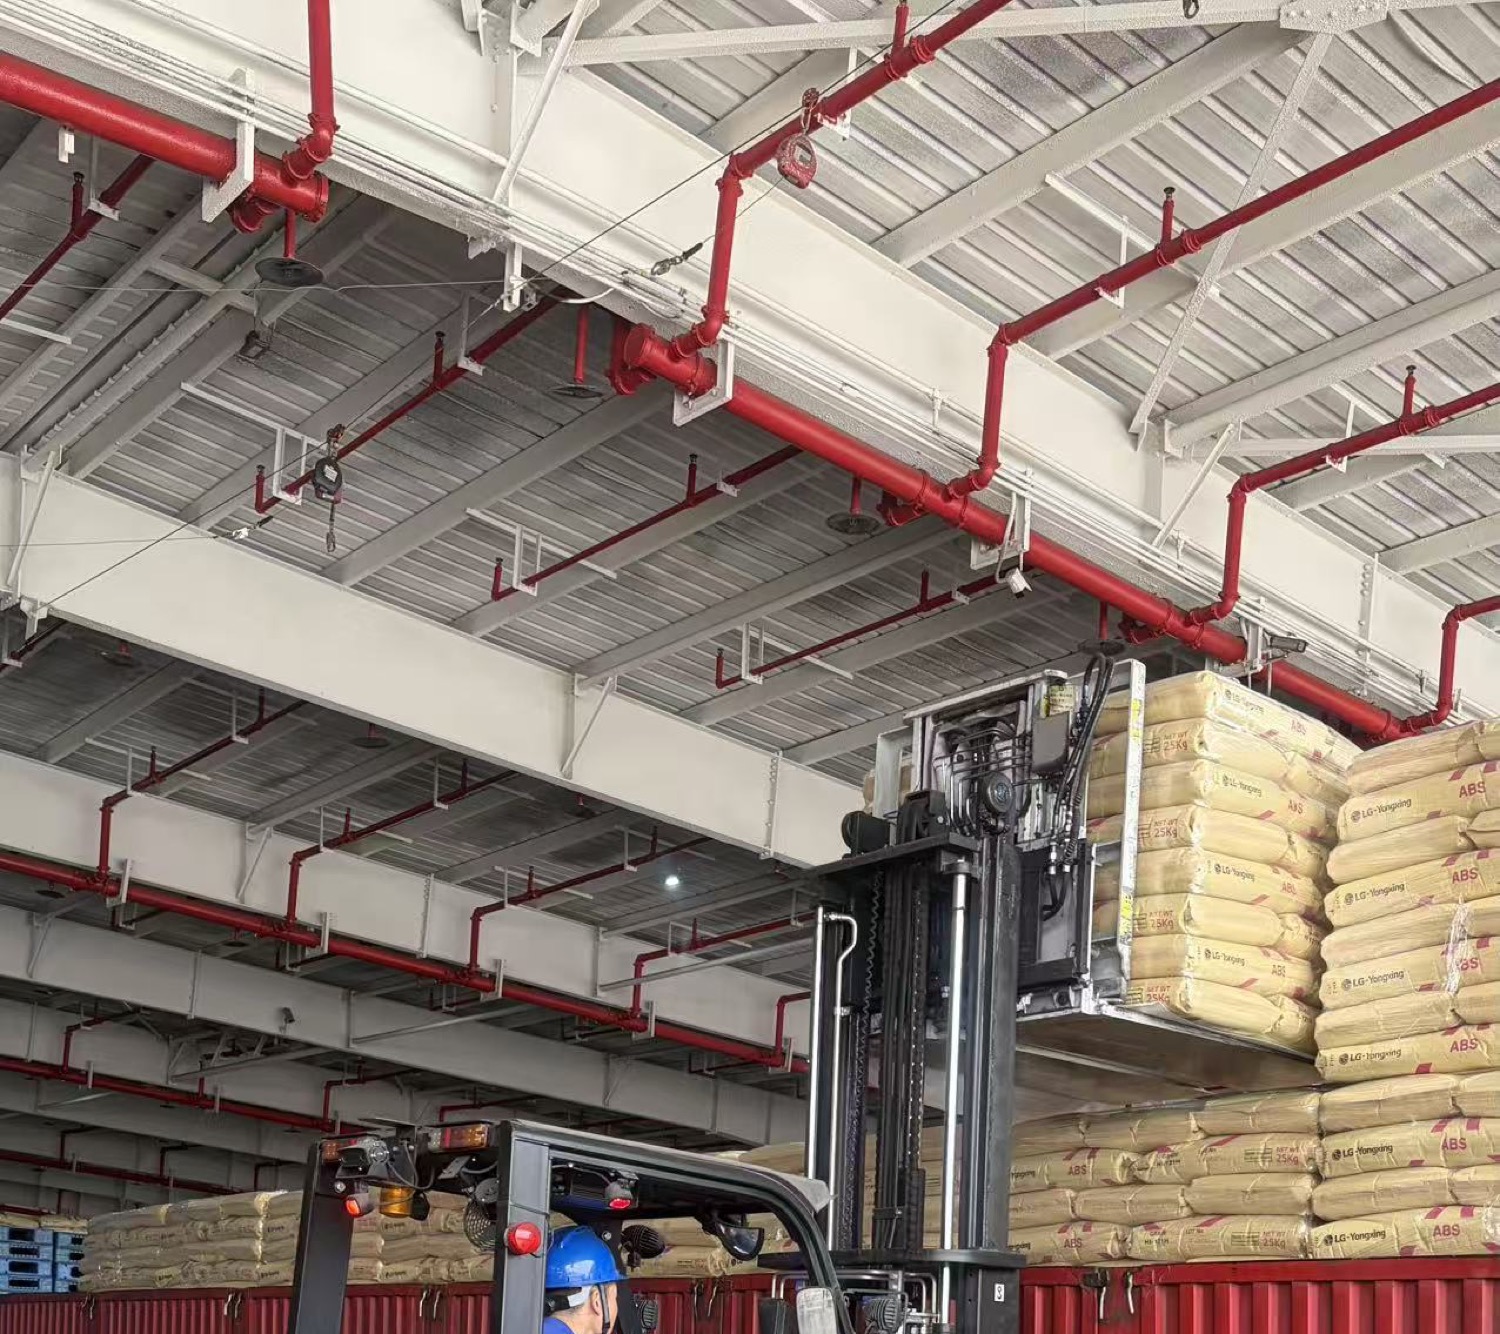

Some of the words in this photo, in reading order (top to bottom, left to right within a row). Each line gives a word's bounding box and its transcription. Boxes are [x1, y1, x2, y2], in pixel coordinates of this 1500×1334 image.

[1163, 739, 1188, 751] 25Kg
[1459, 781, 1486, 798] ABS
[1153, 826, 1178, 838] 25Kg
[1452, 867, 1479, 884] ABS
[1352, 970, 1405, 987] LG-Yongxing
[1450, 1037, 1479, 1053] ABS
[1441, 1137, 1468, 1151] ABS
[1276, 1154, 1299, 1166] 25Kg
[1068, 1165, 1087, 1176] ABS
[1334, 1229, 1386, 1243] LG-Yongxing
[1433, 1224, 1461, 1238] ABS
[1064, 1239, 1083, 1249] ABS
[1262, 1237, 1286, 1249] 25Kg
